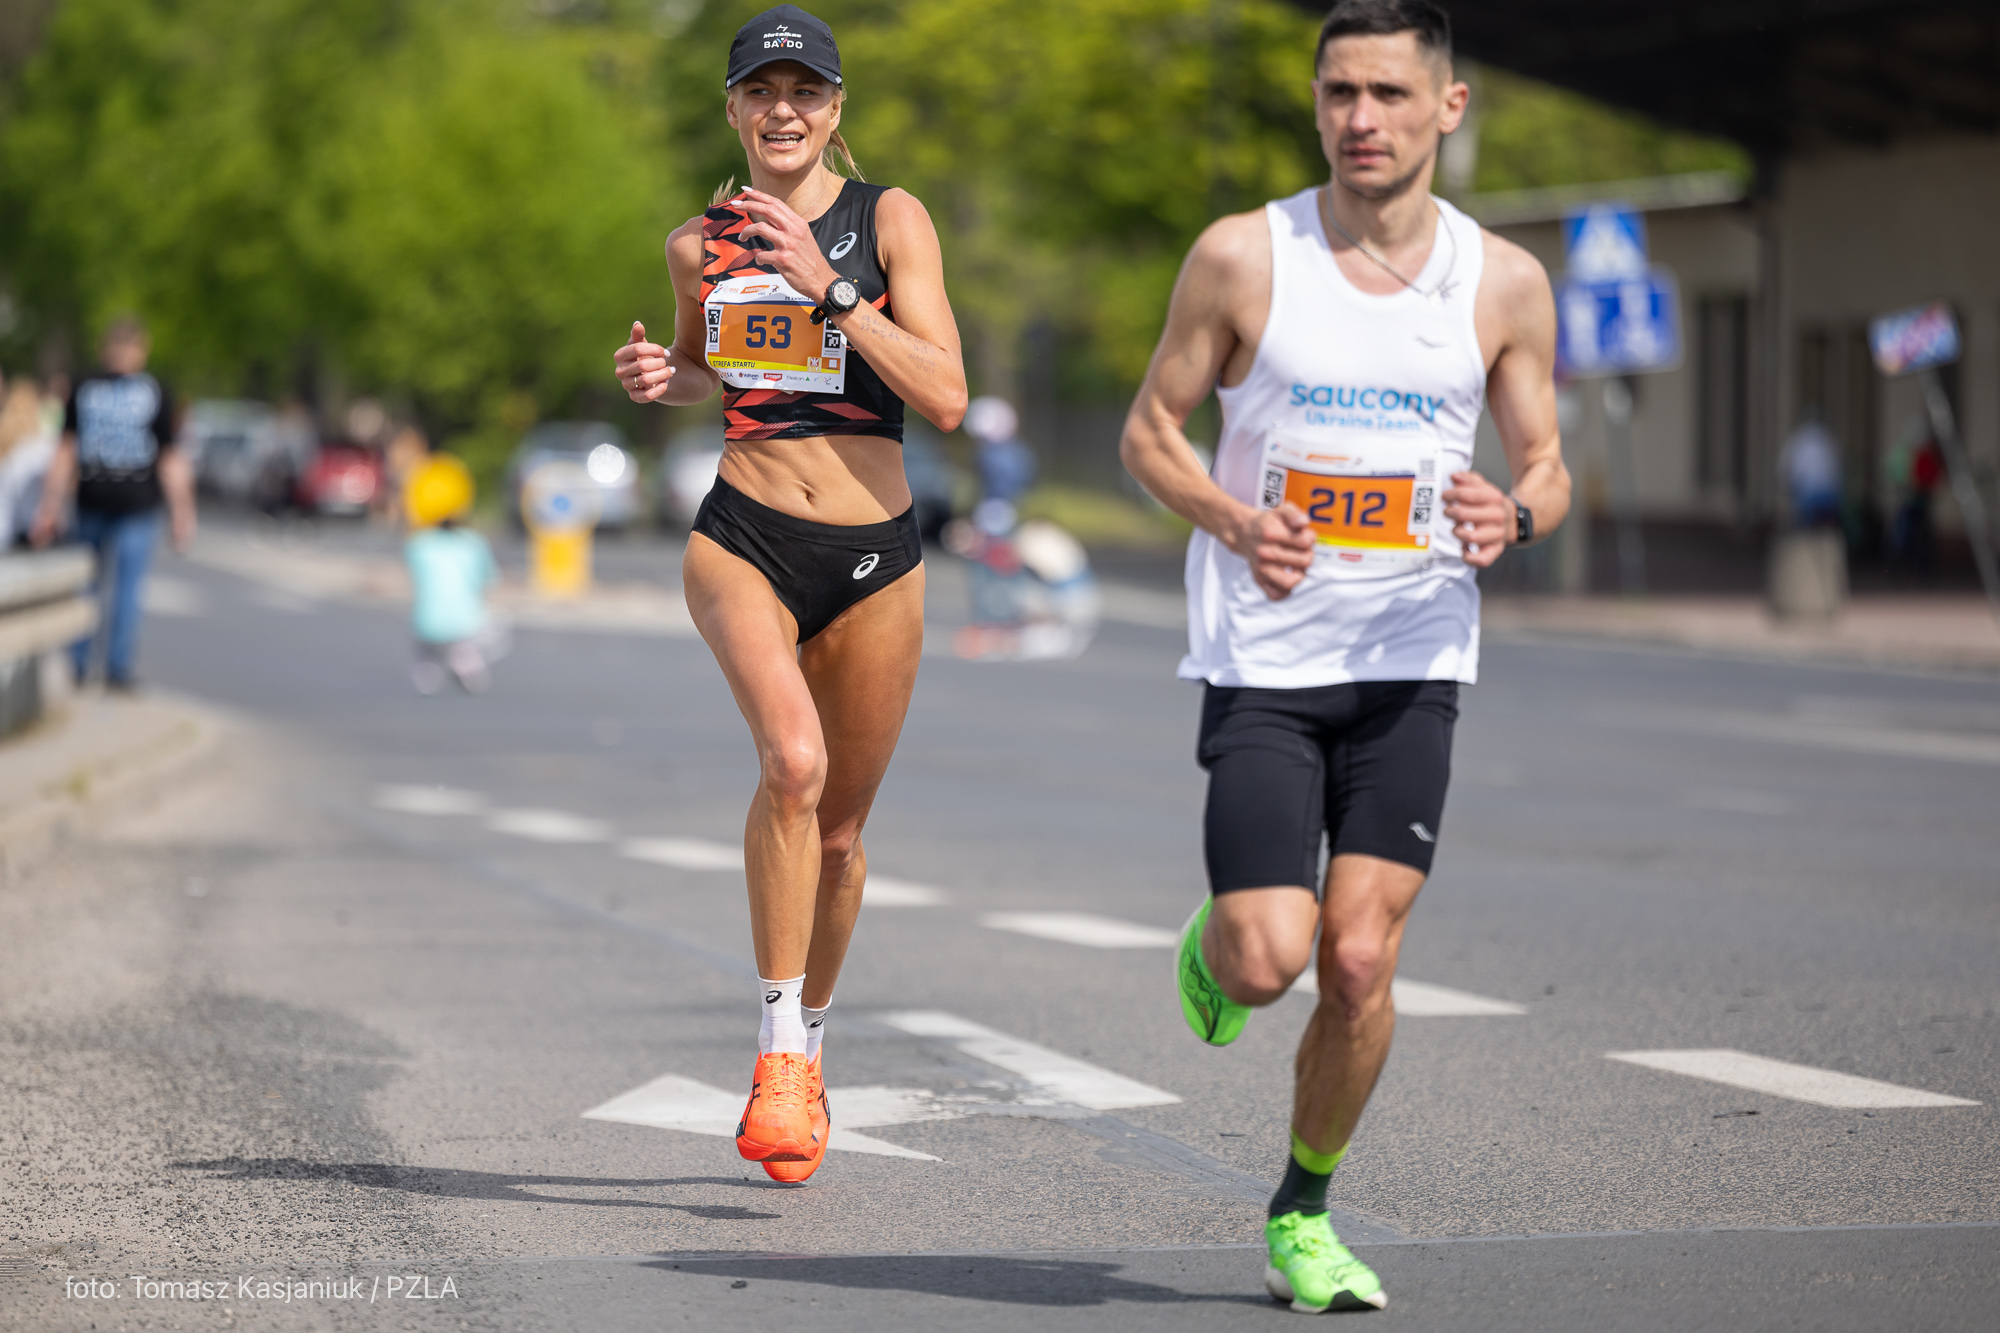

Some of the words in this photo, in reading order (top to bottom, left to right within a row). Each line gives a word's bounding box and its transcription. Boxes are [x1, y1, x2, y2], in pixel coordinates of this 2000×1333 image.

[764, 38, 803, 49] BAYDO
[746, 315, 792, 350] 53
[1290, 384, 1445, 422] saucony
[1305, 410, 1373, 428] Ukraine
[1377, 414, 1421, 431] Team
[1308, 488, 1387, 528] 212
